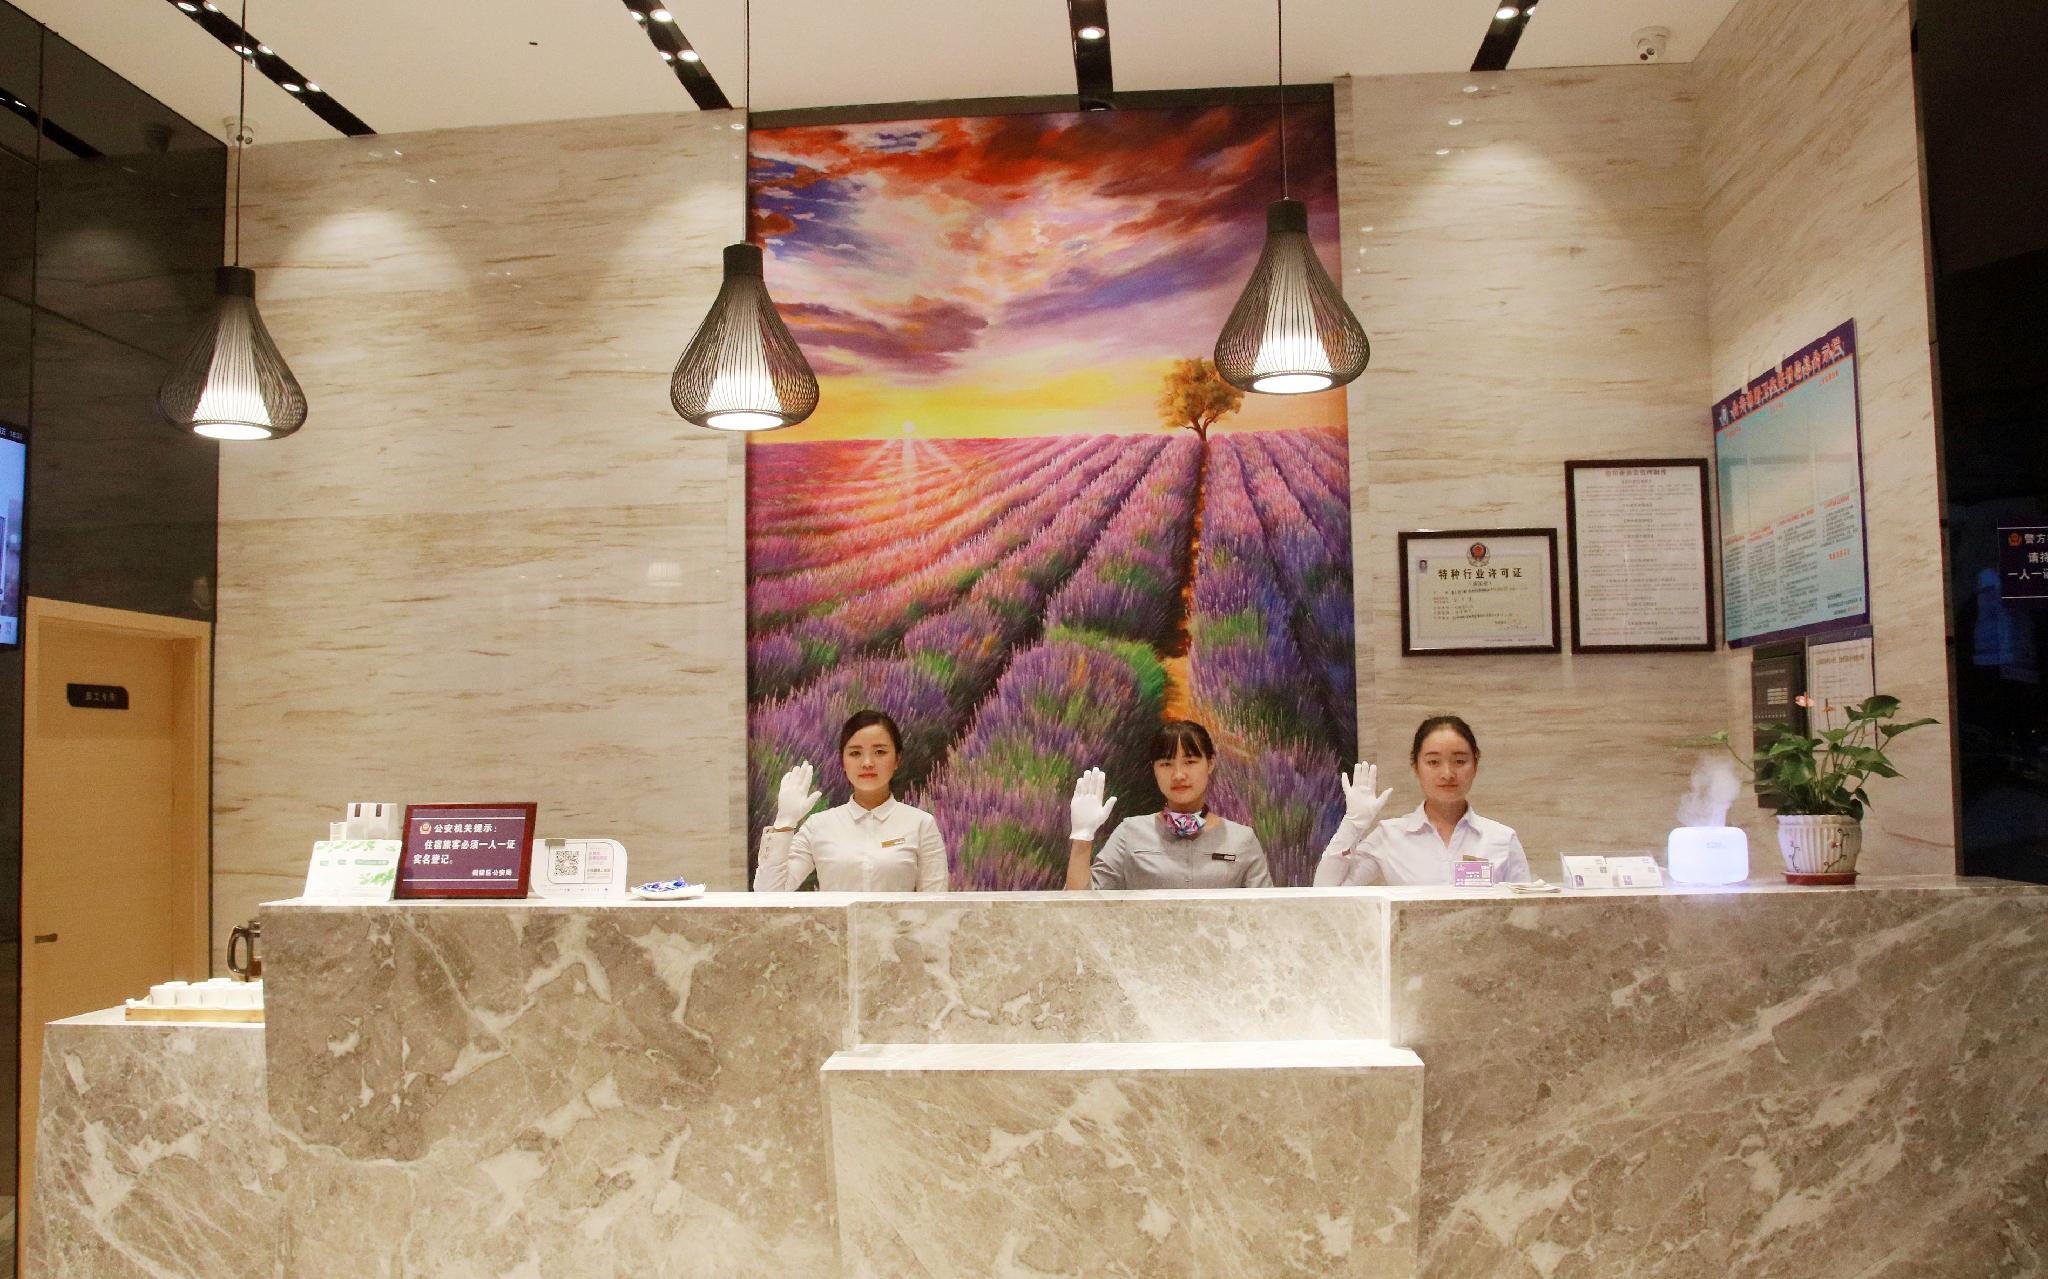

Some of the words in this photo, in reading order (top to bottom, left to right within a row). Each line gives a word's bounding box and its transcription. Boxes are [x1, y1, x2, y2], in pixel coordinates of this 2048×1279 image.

[2024, 533, 2048, 544] 警方
[1438, 567, 1523, 580] 特种行业许可证
[424, 839, 516, 849] 住宿旅客必须一人一证
[413, 854, 454, 864] 实名登记。
